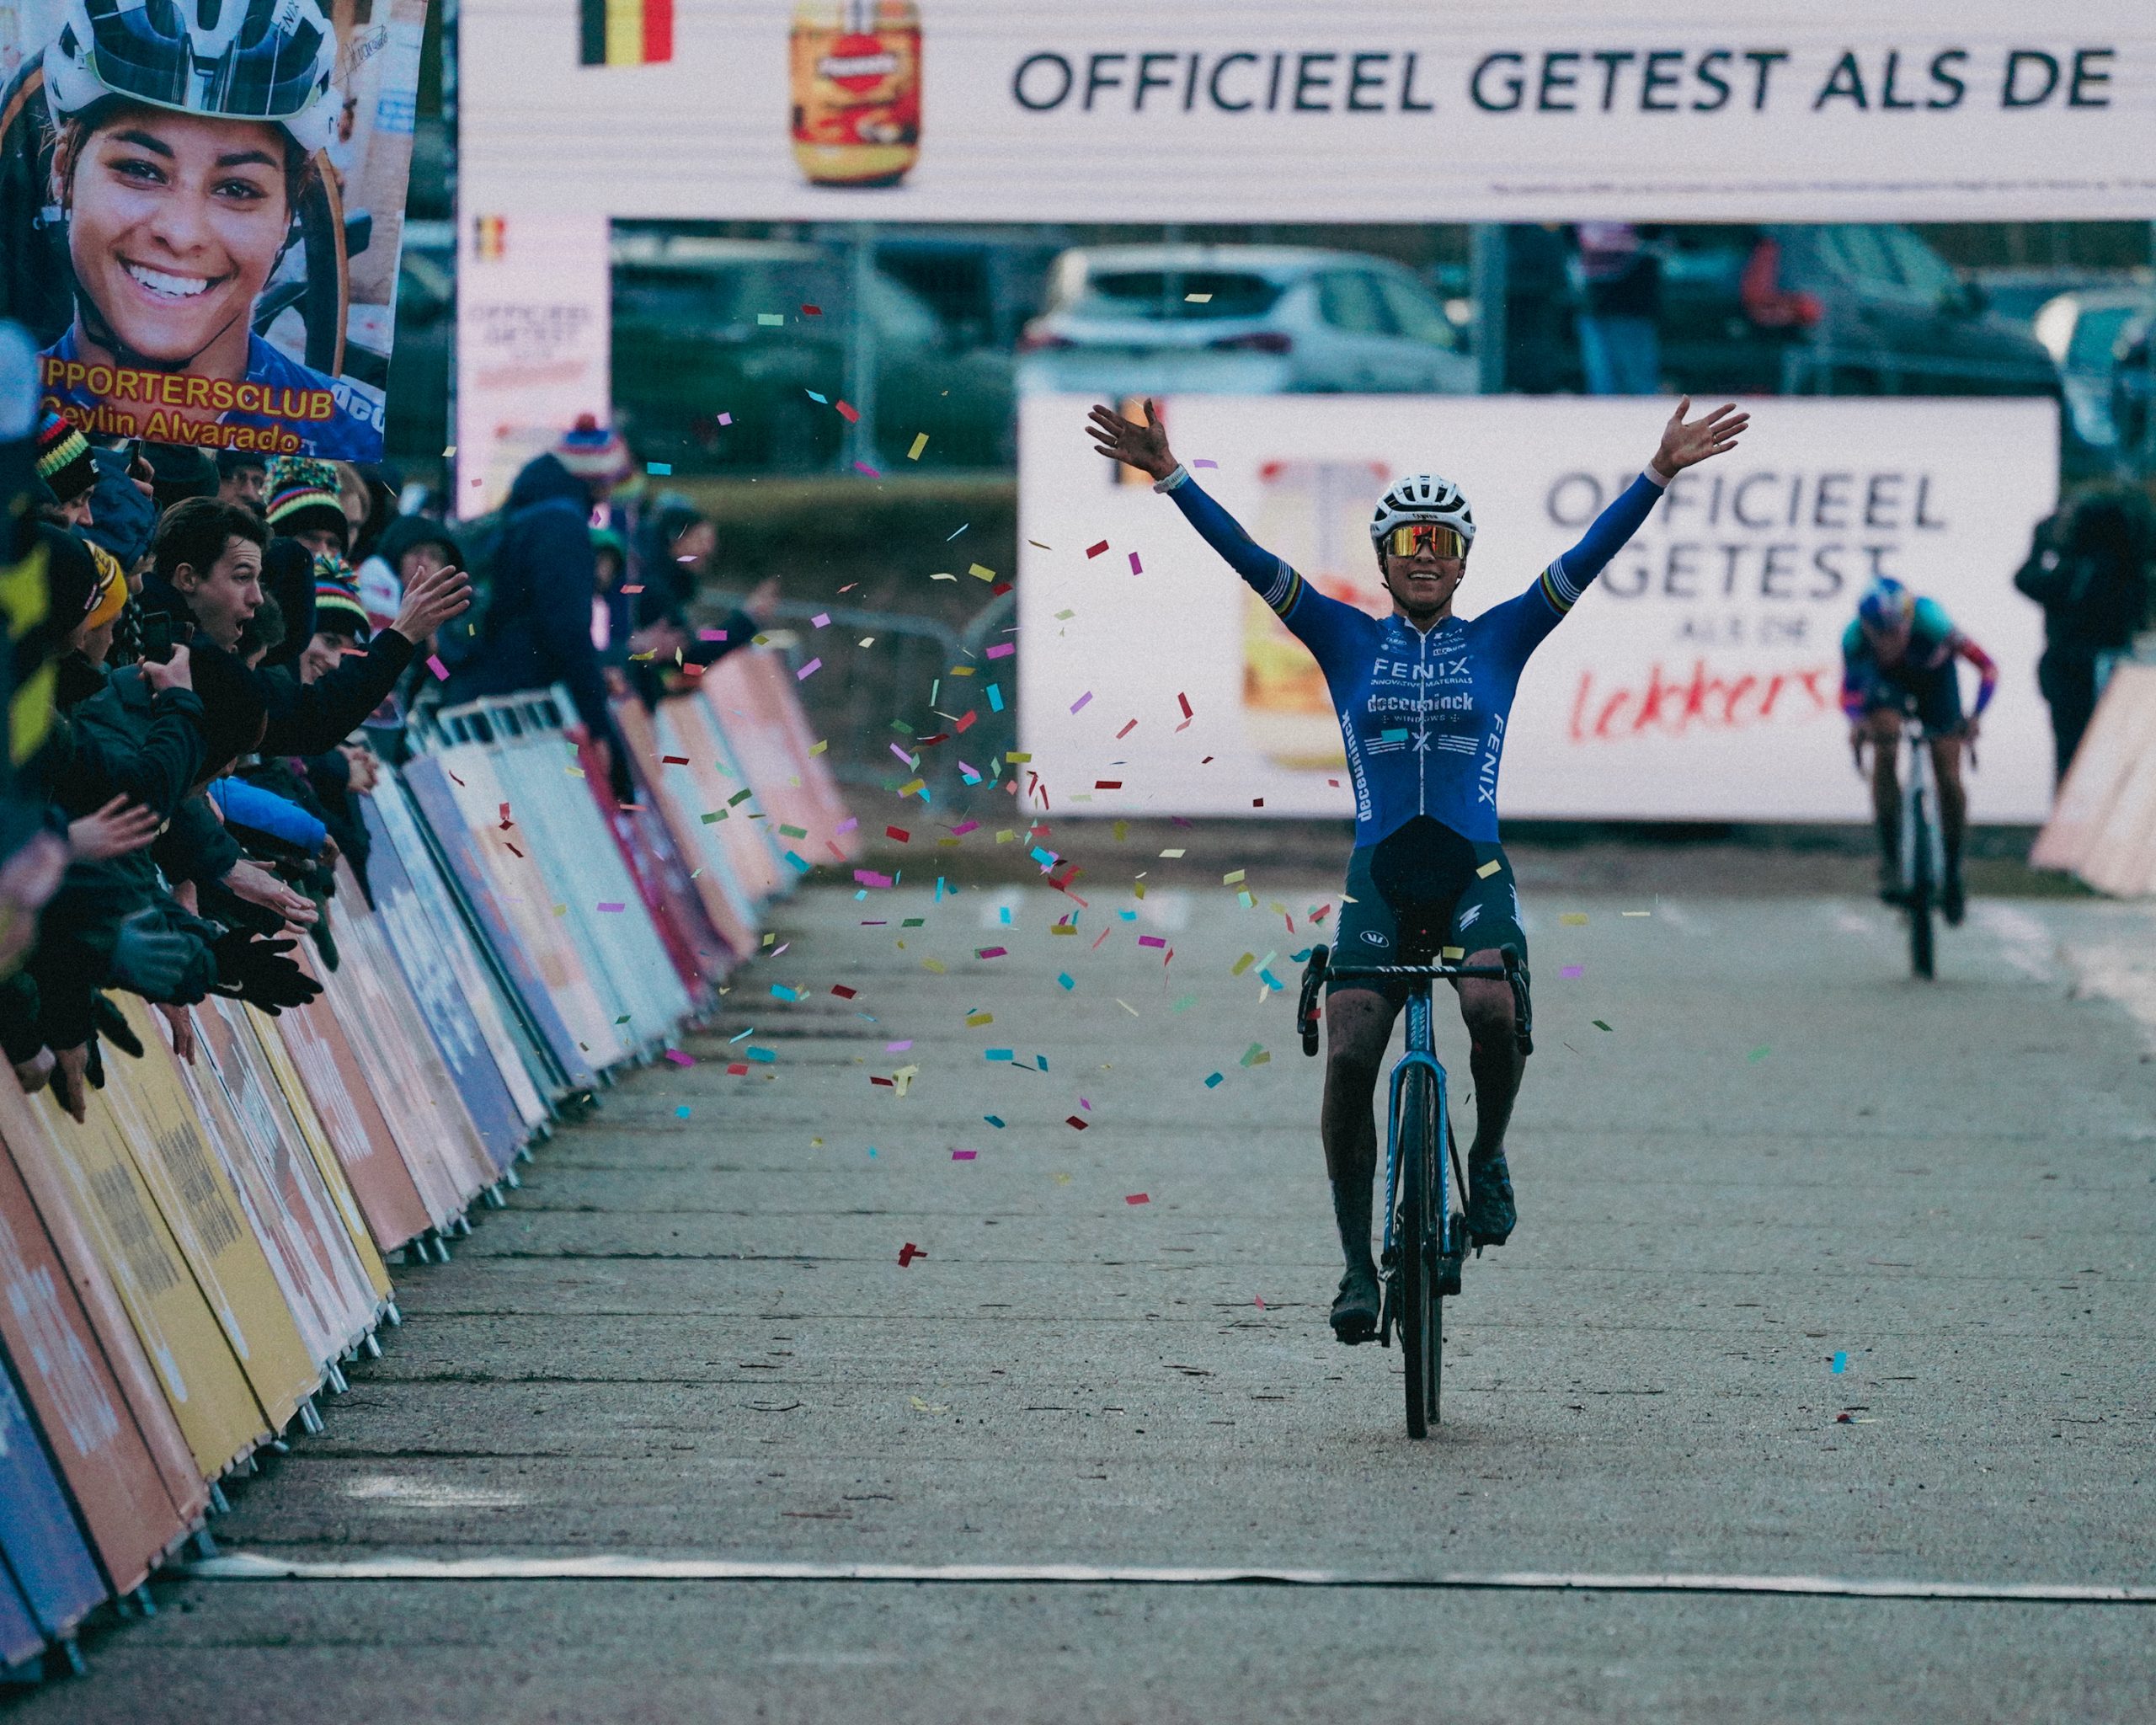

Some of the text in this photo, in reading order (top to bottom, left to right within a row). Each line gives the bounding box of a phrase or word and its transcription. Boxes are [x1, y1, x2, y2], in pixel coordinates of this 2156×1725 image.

[1011, 50, 2116, 112] OFFICIEEL GETEST ALS DE
[144, 411, 301, 454] Alvarado
[1600, 542, 1897, 599] GETEST
[1371, 677, 1474, 689] INNOVATIVE MATERIALS
[1373, 657, 1470, 681] FENIX
[1367, 692, 1474, 713] deceuninck
[1394, 714, 1446, 723] WINDOWS
[1342, 709, 1373, 823] deceuninck
[1477, 713, 1505, 806] FENIX
